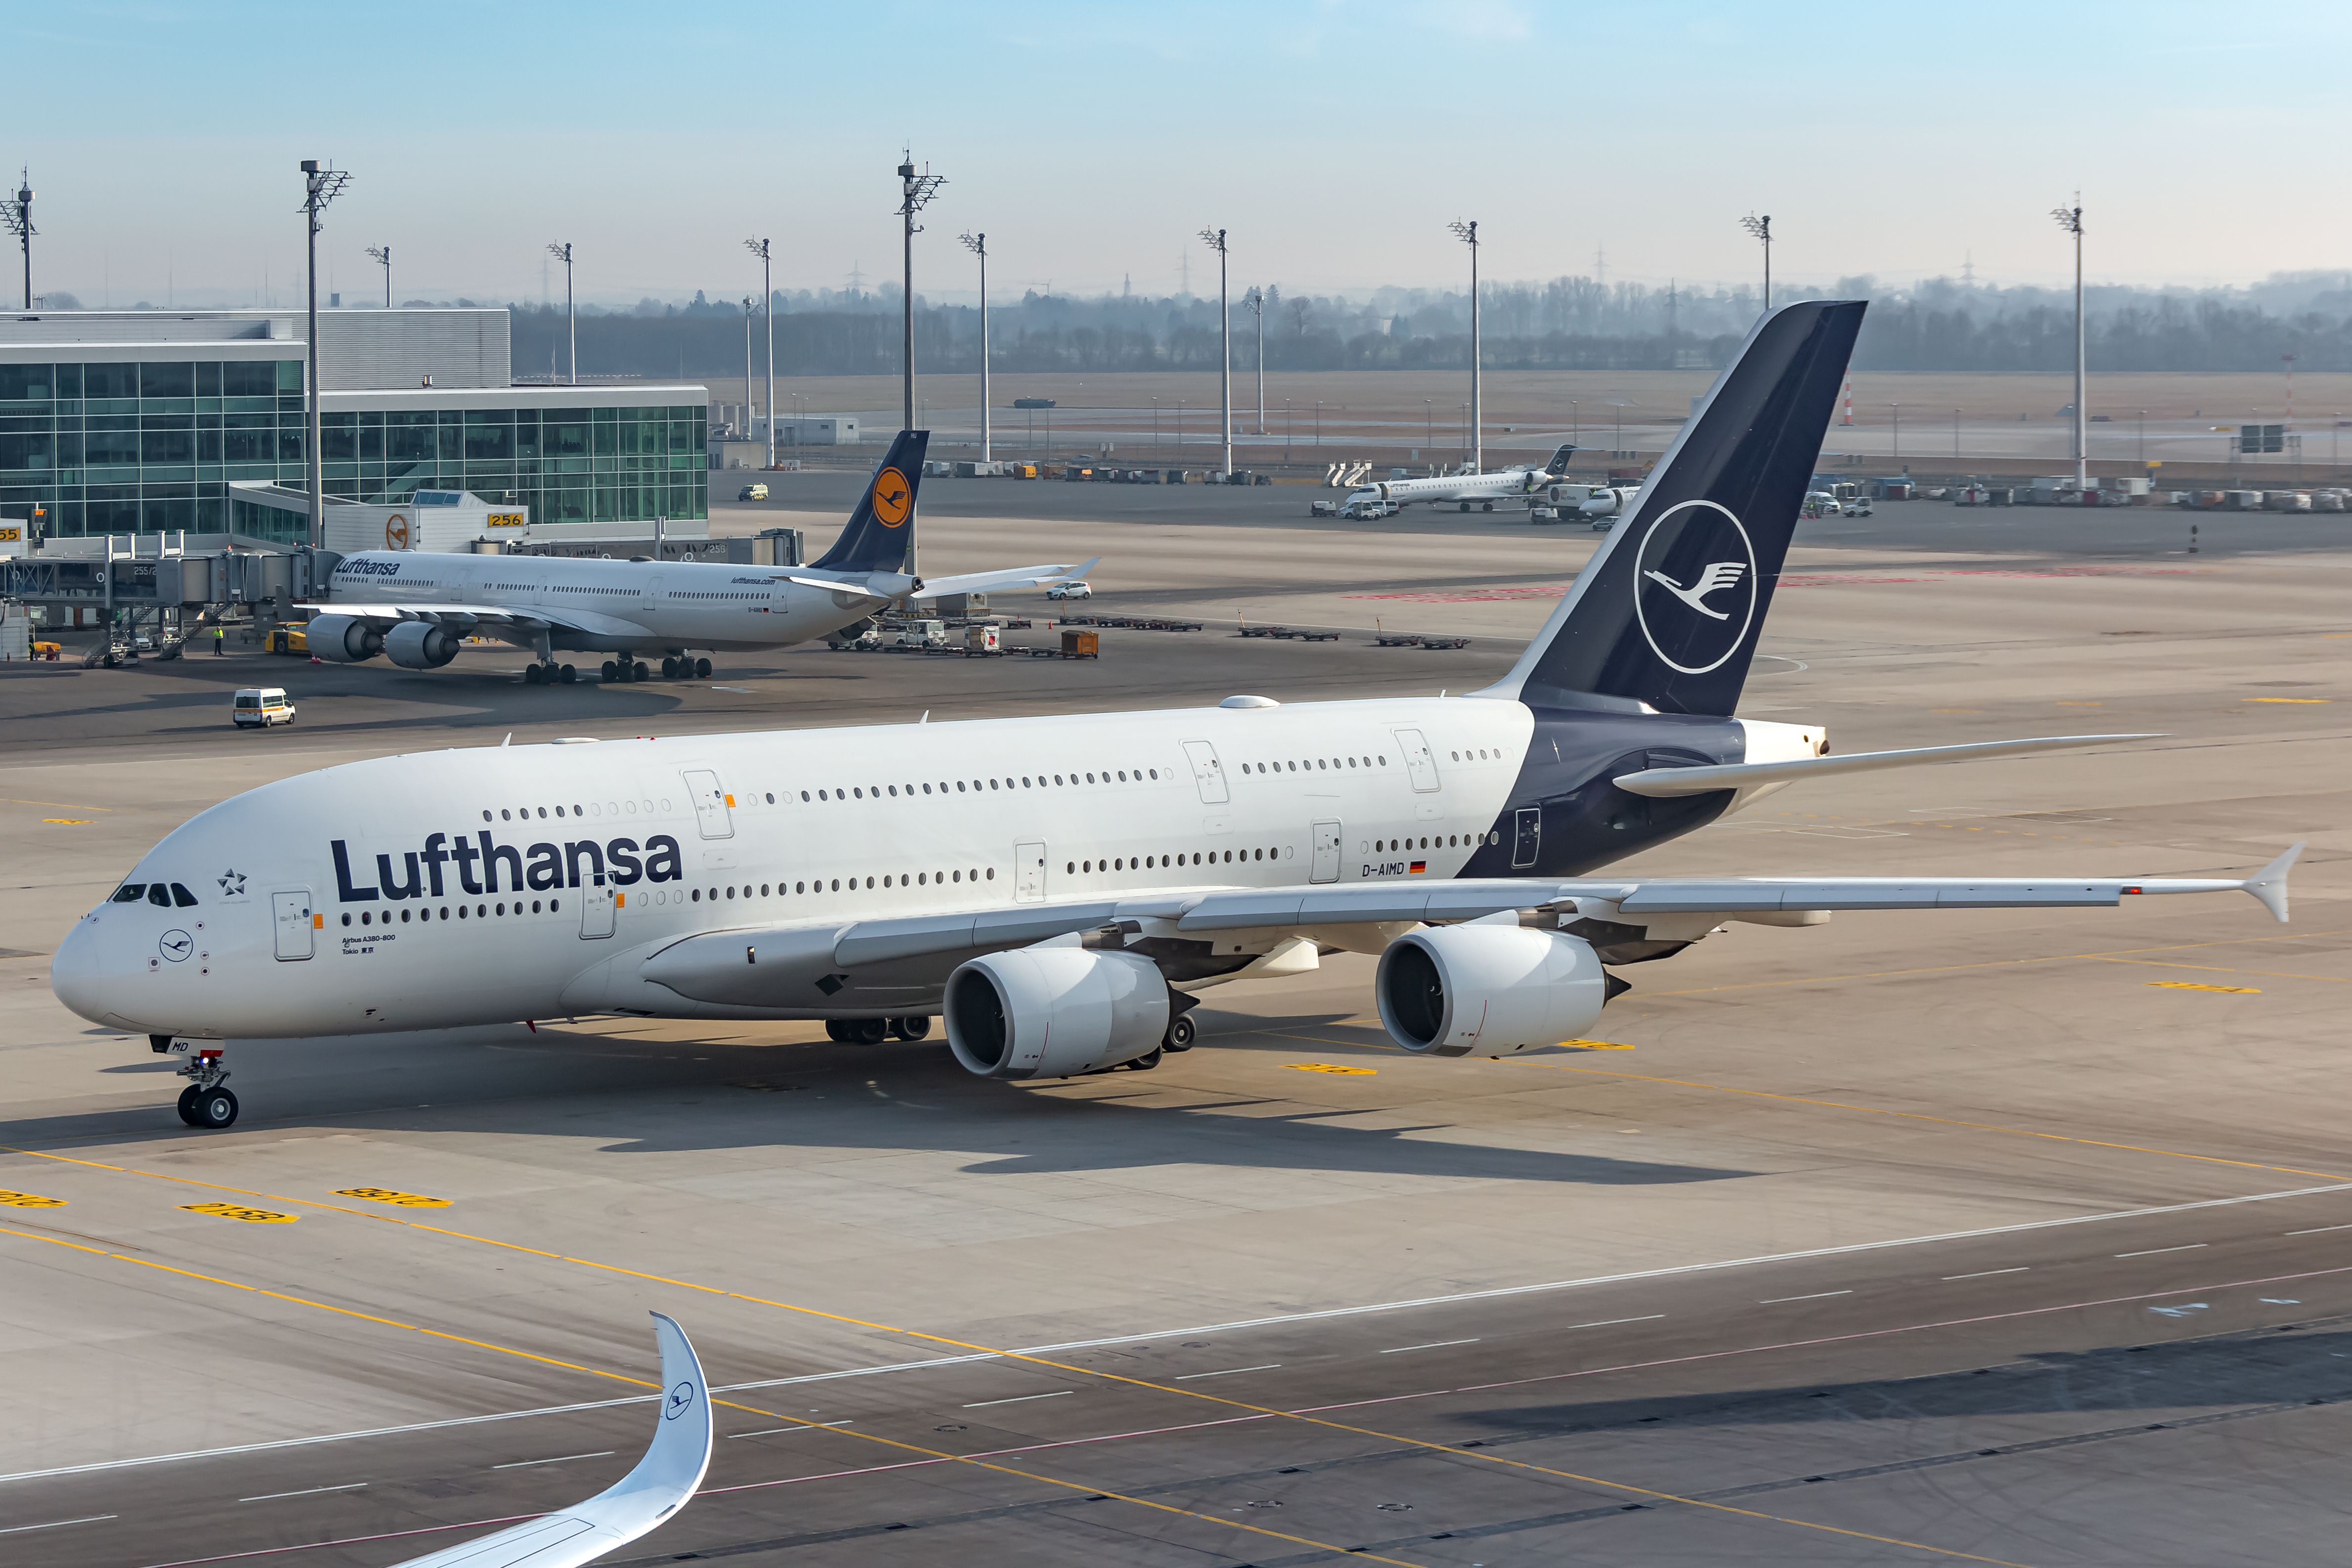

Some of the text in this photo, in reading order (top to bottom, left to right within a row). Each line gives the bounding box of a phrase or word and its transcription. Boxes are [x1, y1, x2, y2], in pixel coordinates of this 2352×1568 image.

[492, 515, 520, 526] 256
[335, 558, 401, 576] Lufthansa
[731, 577, 776, 585] lufthansa.com
[330, 830, 683, 903] Lufthansa
[1362, 862, 1405, 877] D-AIMD
[362, 934, 396, 943] A380-800
[172, 1041, 188, 1052] MD
[179, 1203, 285, 1221] 215B
